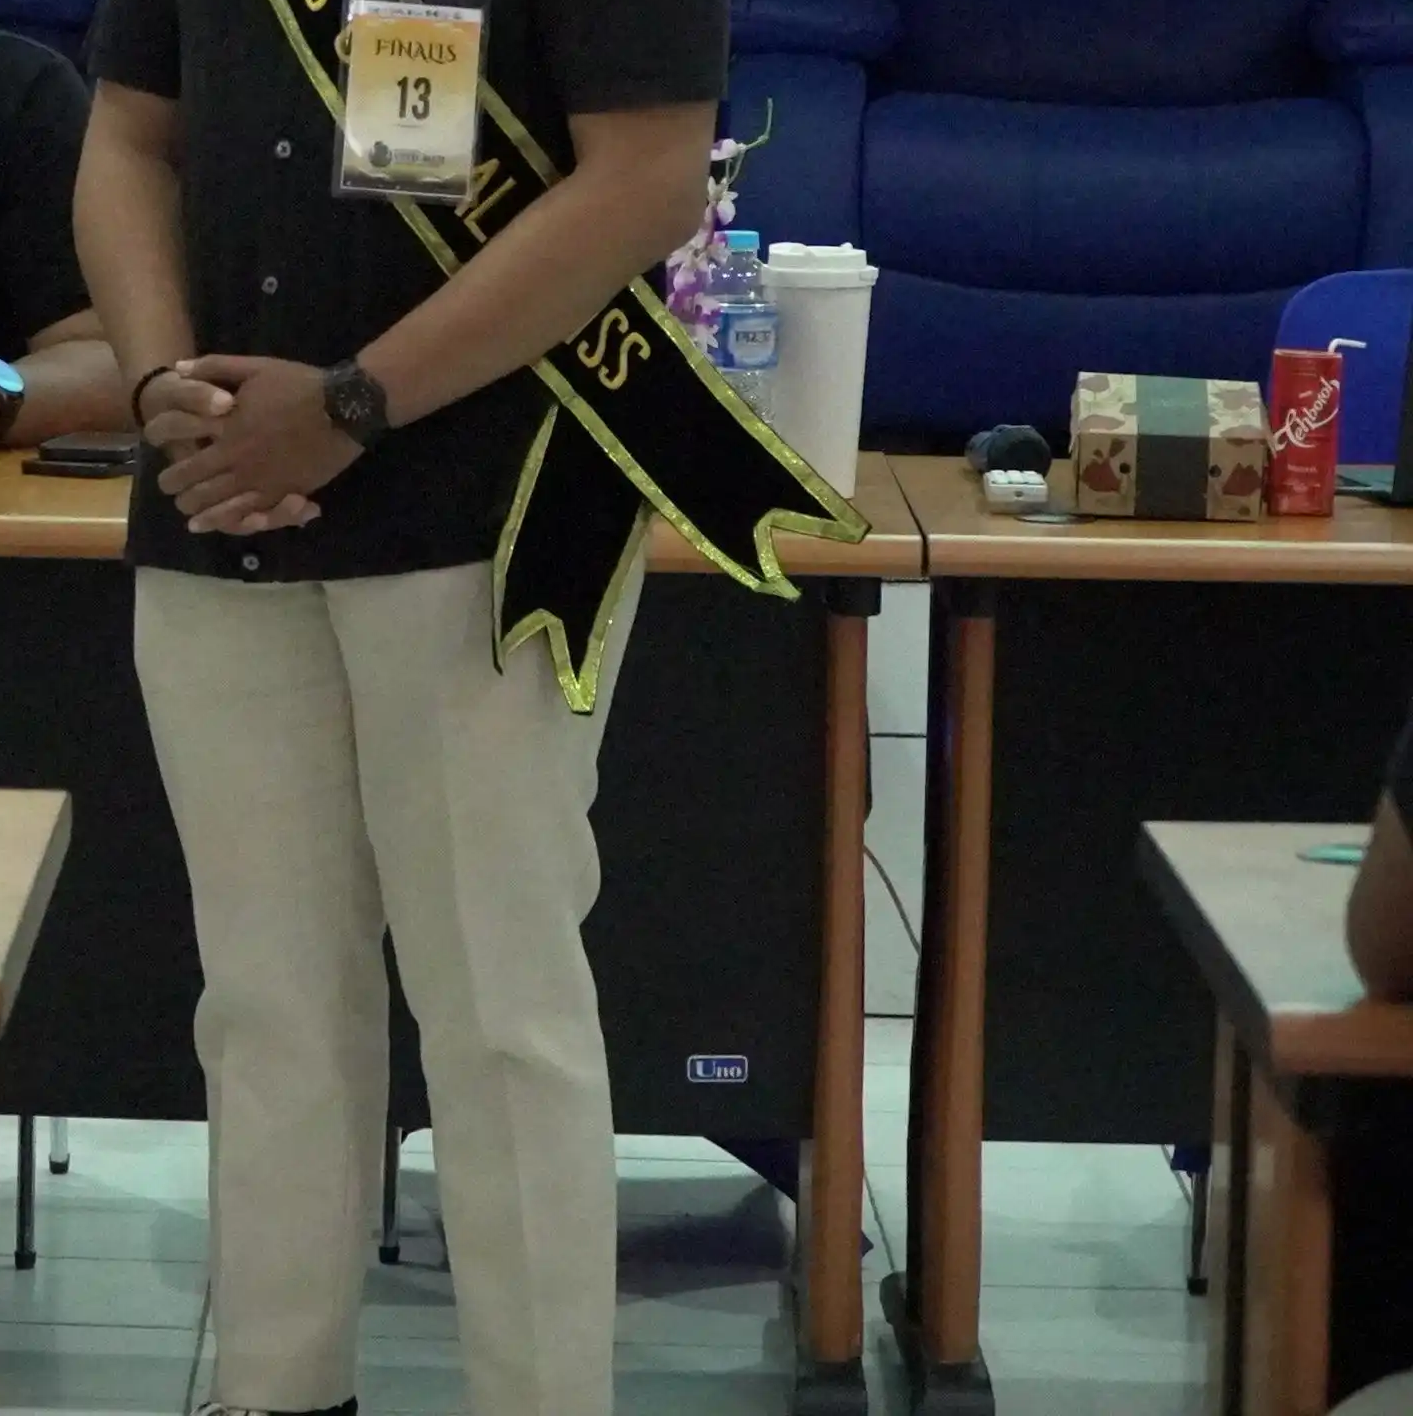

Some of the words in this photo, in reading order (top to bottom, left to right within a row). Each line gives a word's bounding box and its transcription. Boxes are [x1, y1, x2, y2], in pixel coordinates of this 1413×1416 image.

[374, 37, 457, 65] FINALIS
[397, 76, 432, 120] 13
[695, 1060, 742, 1078] Uno
